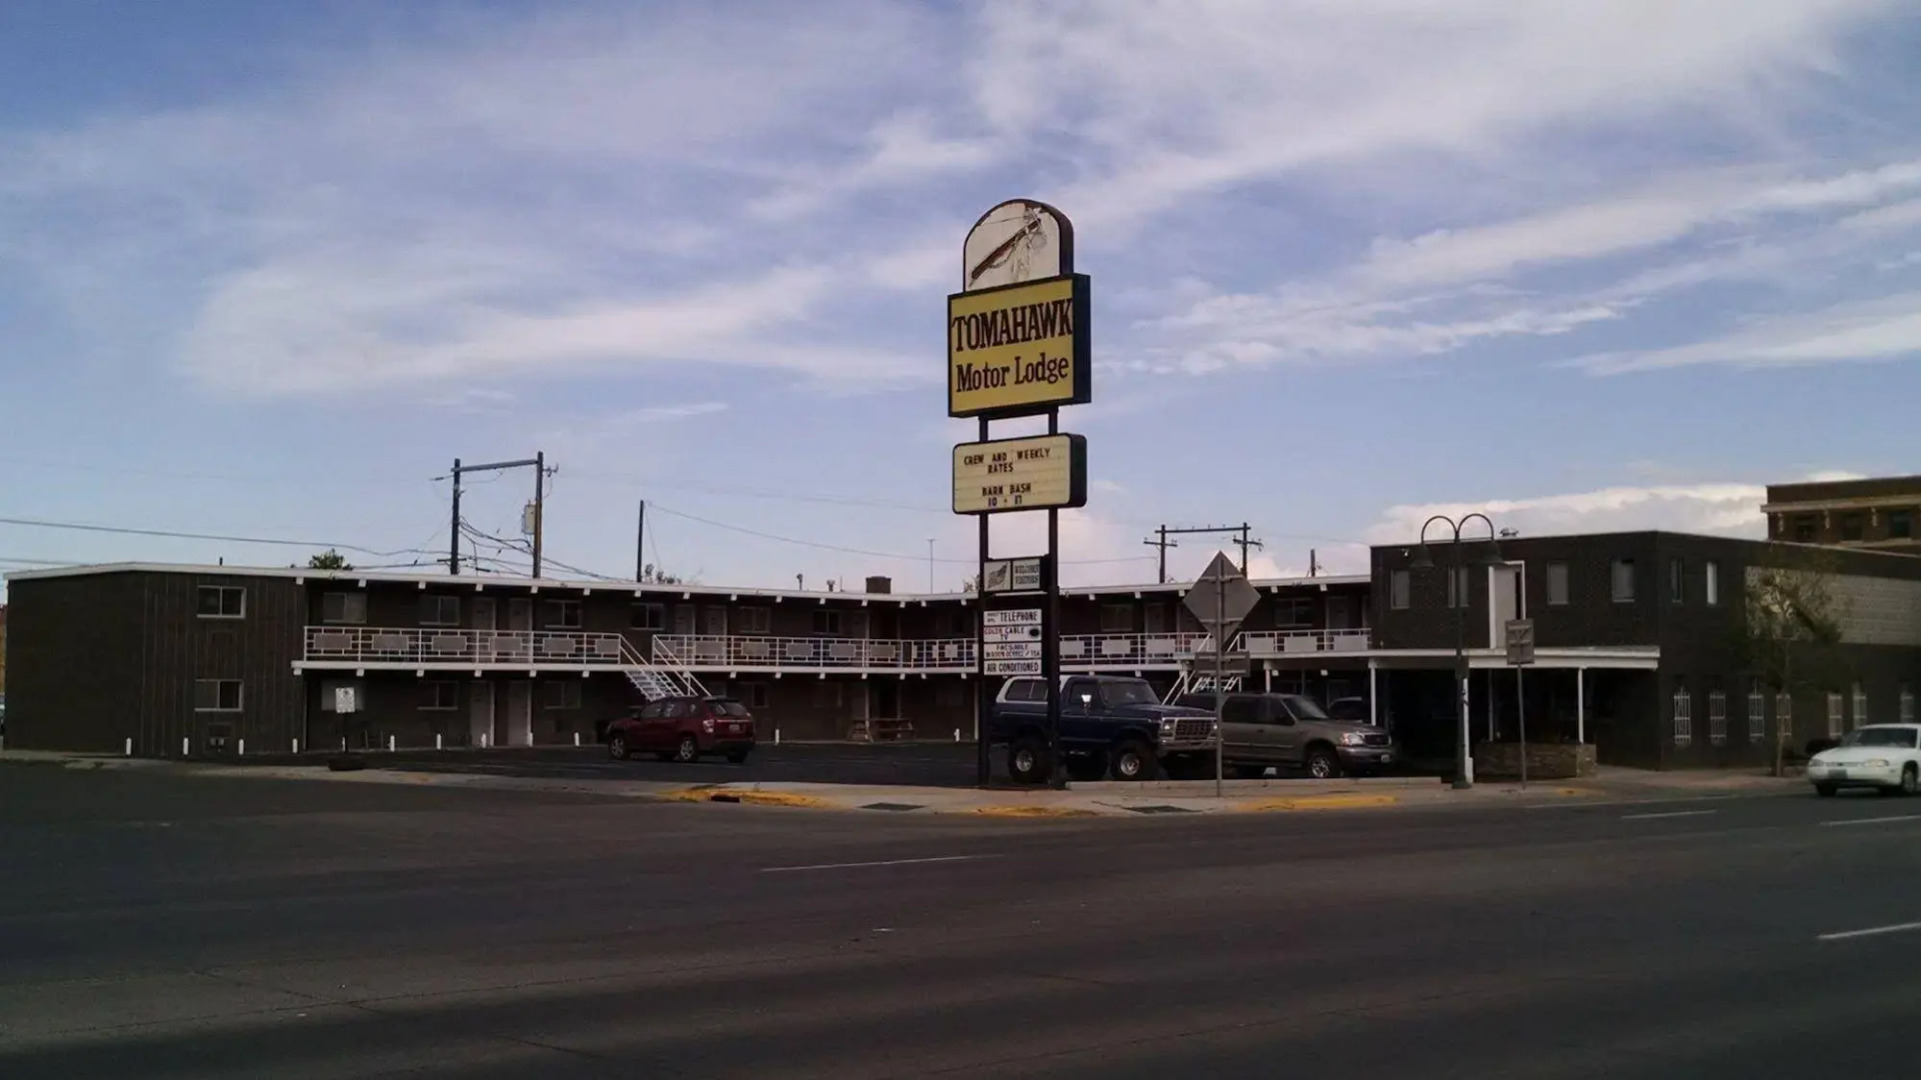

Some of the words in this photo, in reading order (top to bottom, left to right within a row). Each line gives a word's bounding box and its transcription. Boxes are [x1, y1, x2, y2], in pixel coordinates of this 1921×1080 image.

[952, 298, 1073, 352] TOMAHAWK
[956, 362, 1010, 393] Motor
[1014, 352, 1069, 384] Lodge
[964, 454, 984, 466] CREW
[991, 452, 1007, 462] AND
[1017, 448, 1051, 460] WEEKLY
[988, 463, 1014, 474] RATES
[982, 485, 1003, 496] BARN
[1009, 483, 1031, 494] BASH
[988, 497, 998, 507] 10
[1000, 611, 1038, 622] TELEPHONE
[984, 627, 1003, 635] COLOR
[987, 662, 997, 672] AIR
[998, 662, 1039, 672] CONDITIONED
